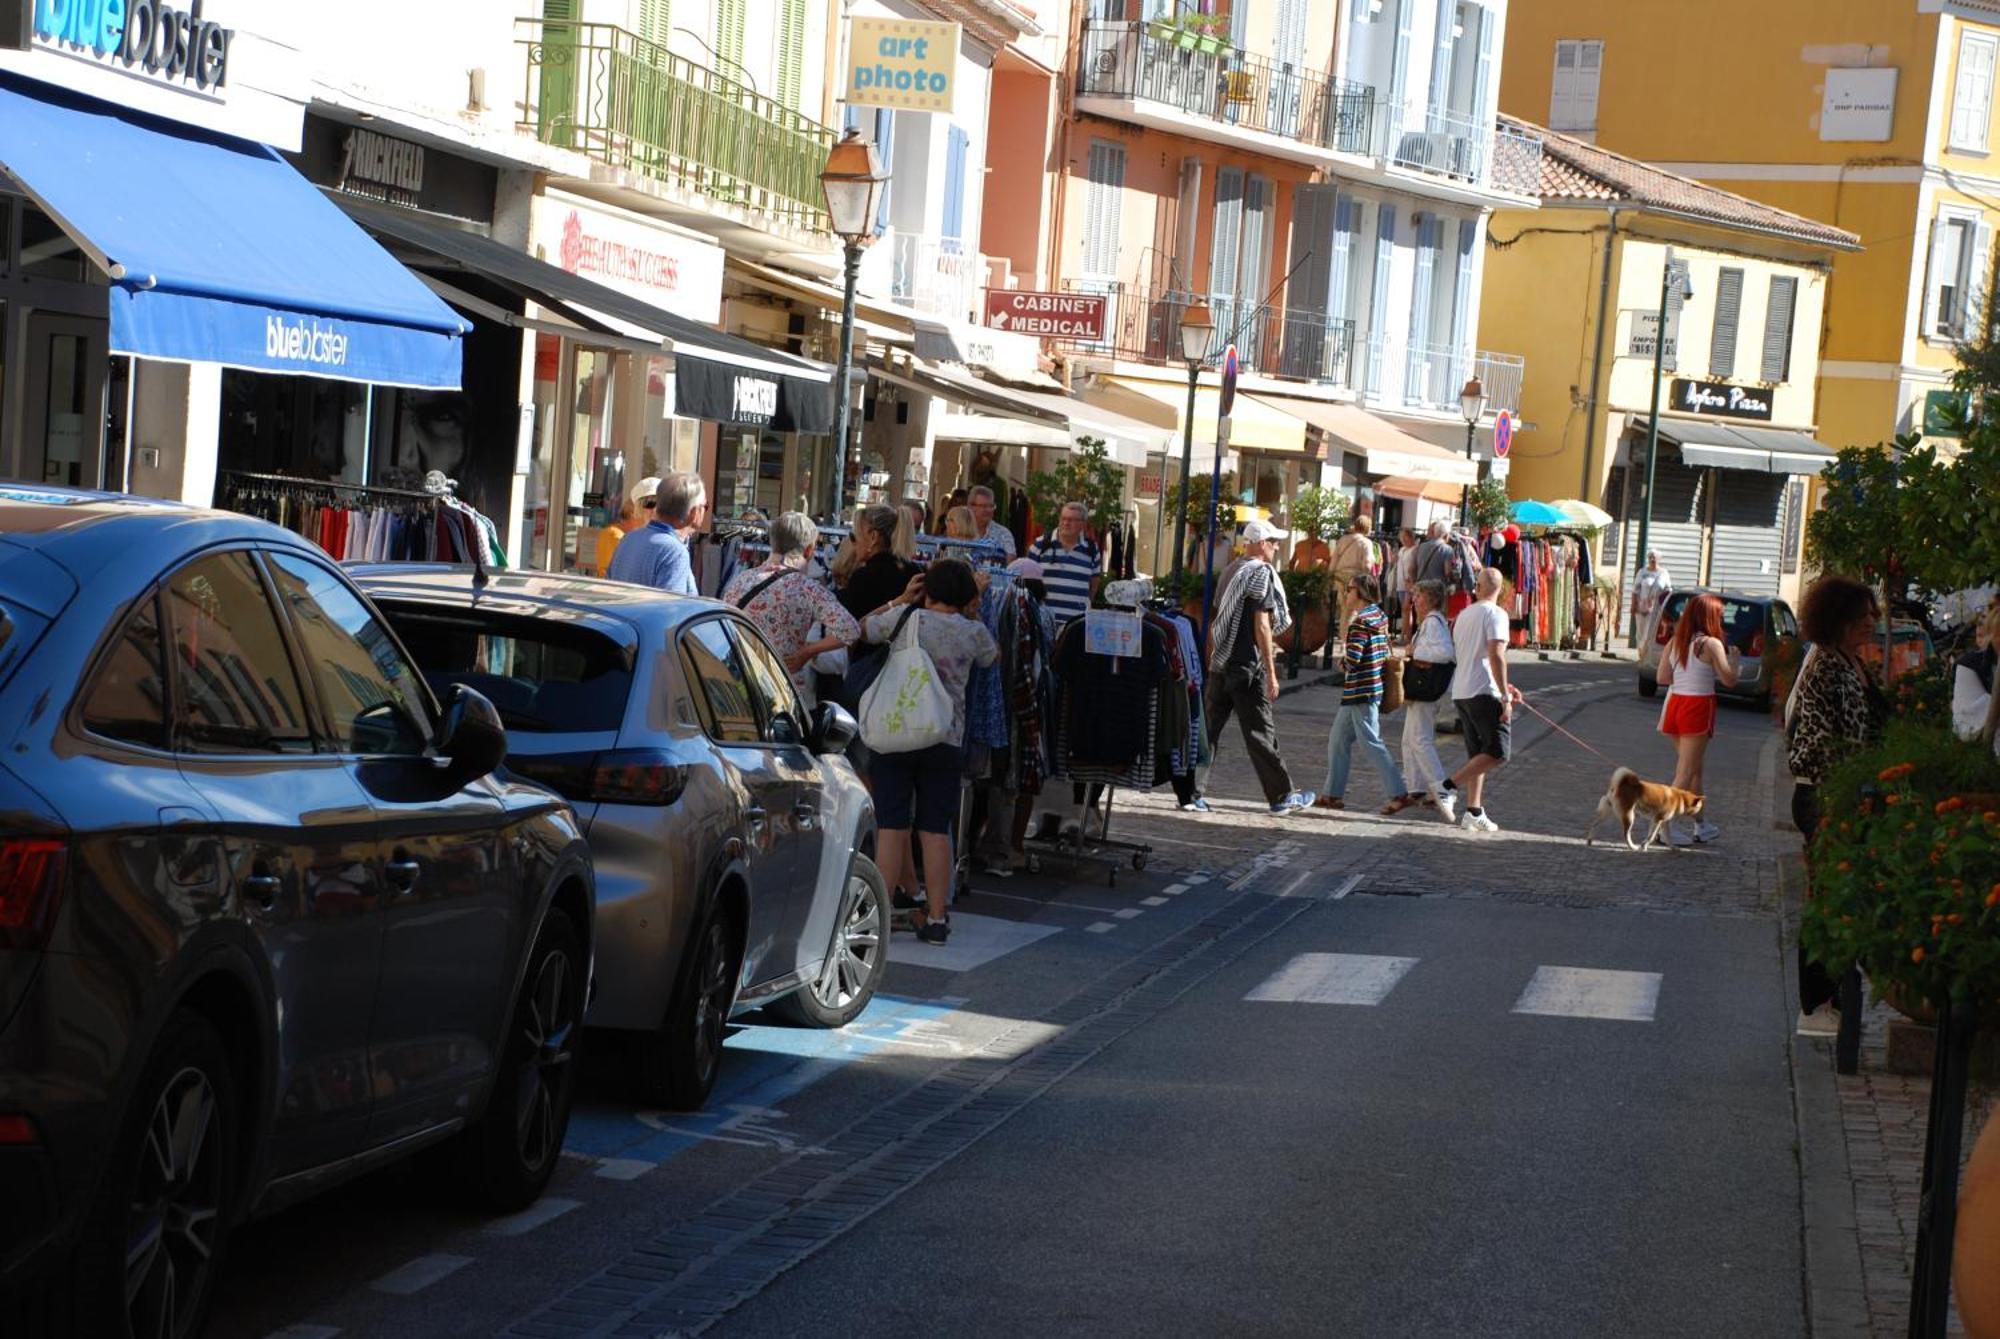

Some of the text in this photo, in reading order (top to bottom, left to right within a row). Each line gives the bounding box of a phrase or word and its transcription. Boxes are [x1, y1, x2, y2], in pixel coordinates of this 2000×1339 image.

[878, 36, 928, 60] art
[853, 64, 947, 93] photo
[1012, 295, 1098, 315] CABINET
[1010, 316, 1098, 336] MEDICAL
[1685, 381, 1768, 413] Apéro Pizza
